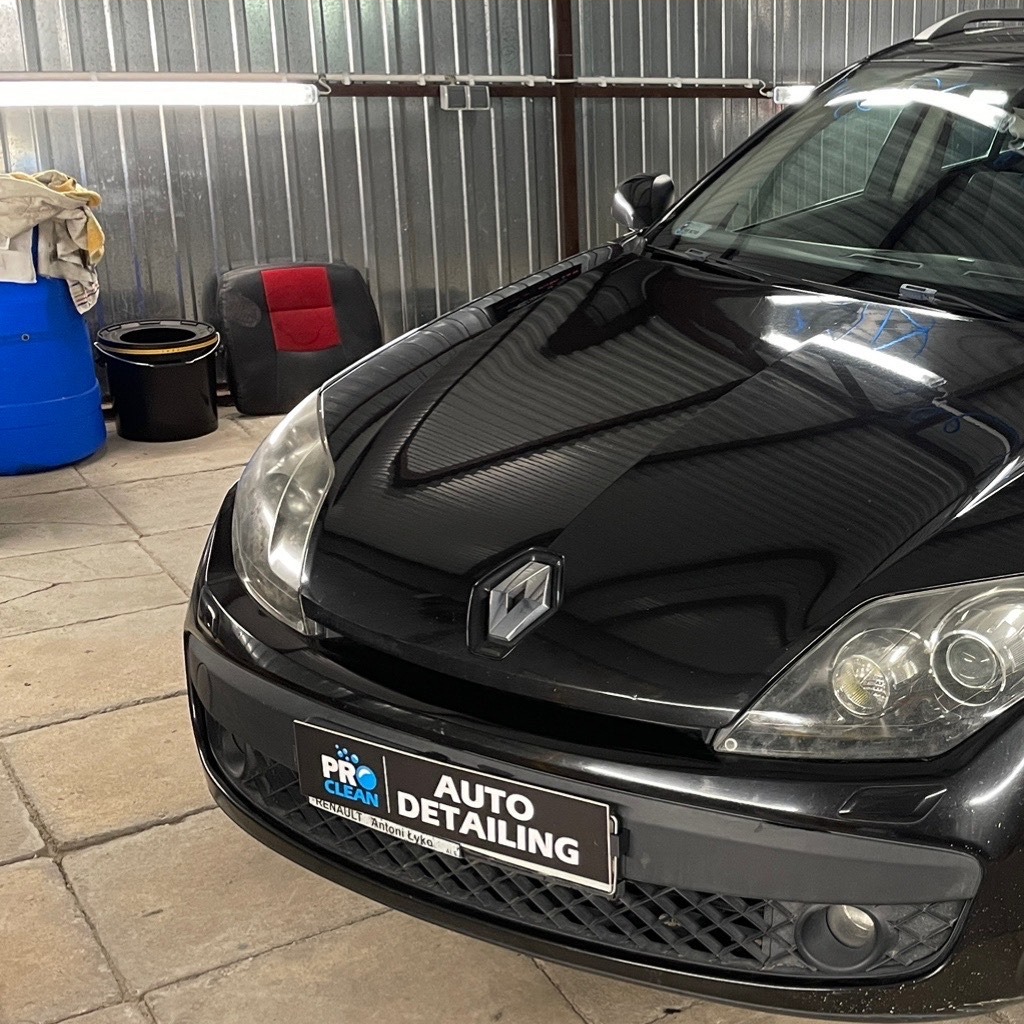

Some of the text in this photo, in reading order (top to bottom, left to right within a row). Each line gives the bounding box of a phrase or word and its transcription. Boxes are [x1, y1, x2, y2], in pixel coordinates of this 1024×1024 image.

[321, 754, 377, 791] PRO
[324, 779, 379, 808] CLEAN
[433, 775, 534, 821] AUTO
[315, 798, 363, 822] RENAULT
[371, 816, 404, 836] Antoni
[397, 791, 579, 865] DETAILING
